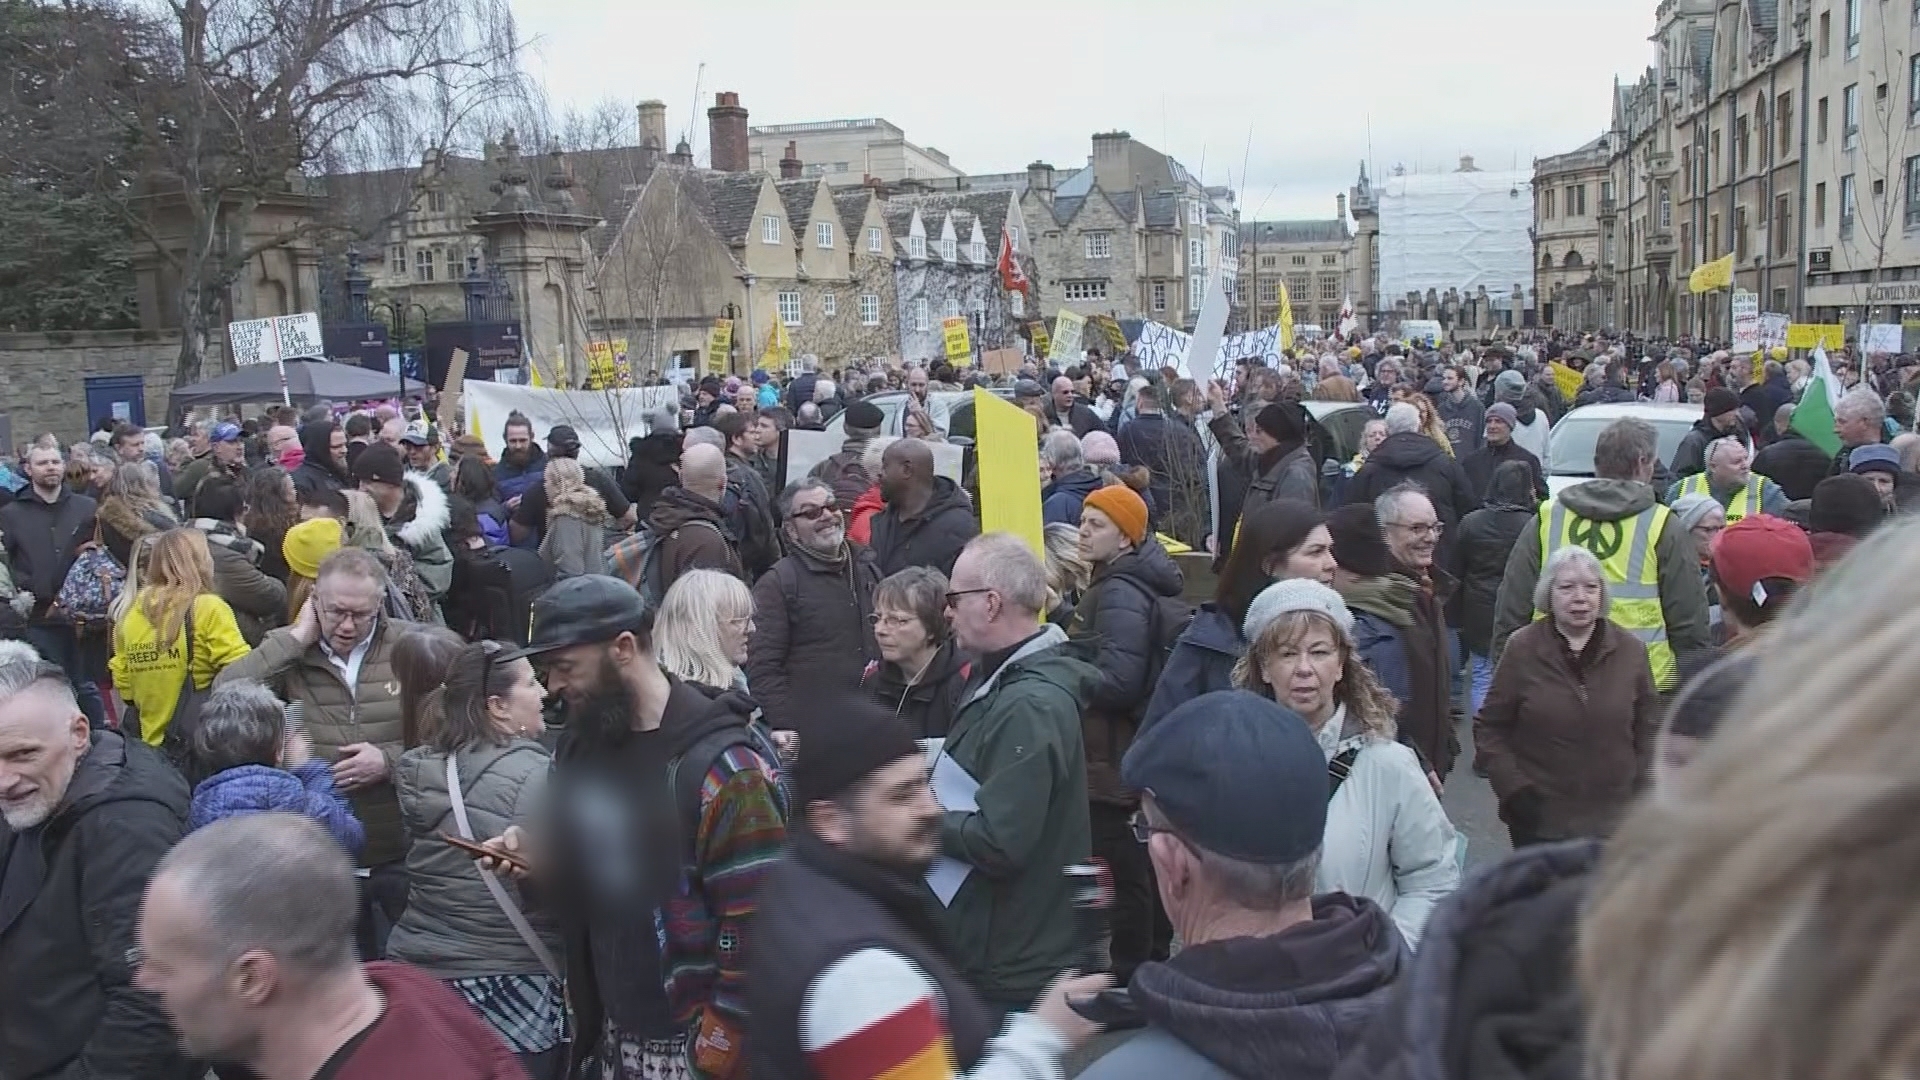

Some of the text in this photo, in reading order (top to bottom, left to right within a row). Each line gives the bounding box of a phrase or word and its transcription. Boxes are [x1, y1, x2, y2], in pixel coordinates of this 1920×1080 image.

[1734, 294, 1757, 303] SAY NO
[278, 315, 308, 325] DYSTO
[232, 320, 270, 332] UTOPIA
[232, 330, 262, 340] FAITH
[234, 338, 261, 348] LOVE
[281, 344, 322, 358] SLAVERY
[130, 642, 154, 651] STAND
